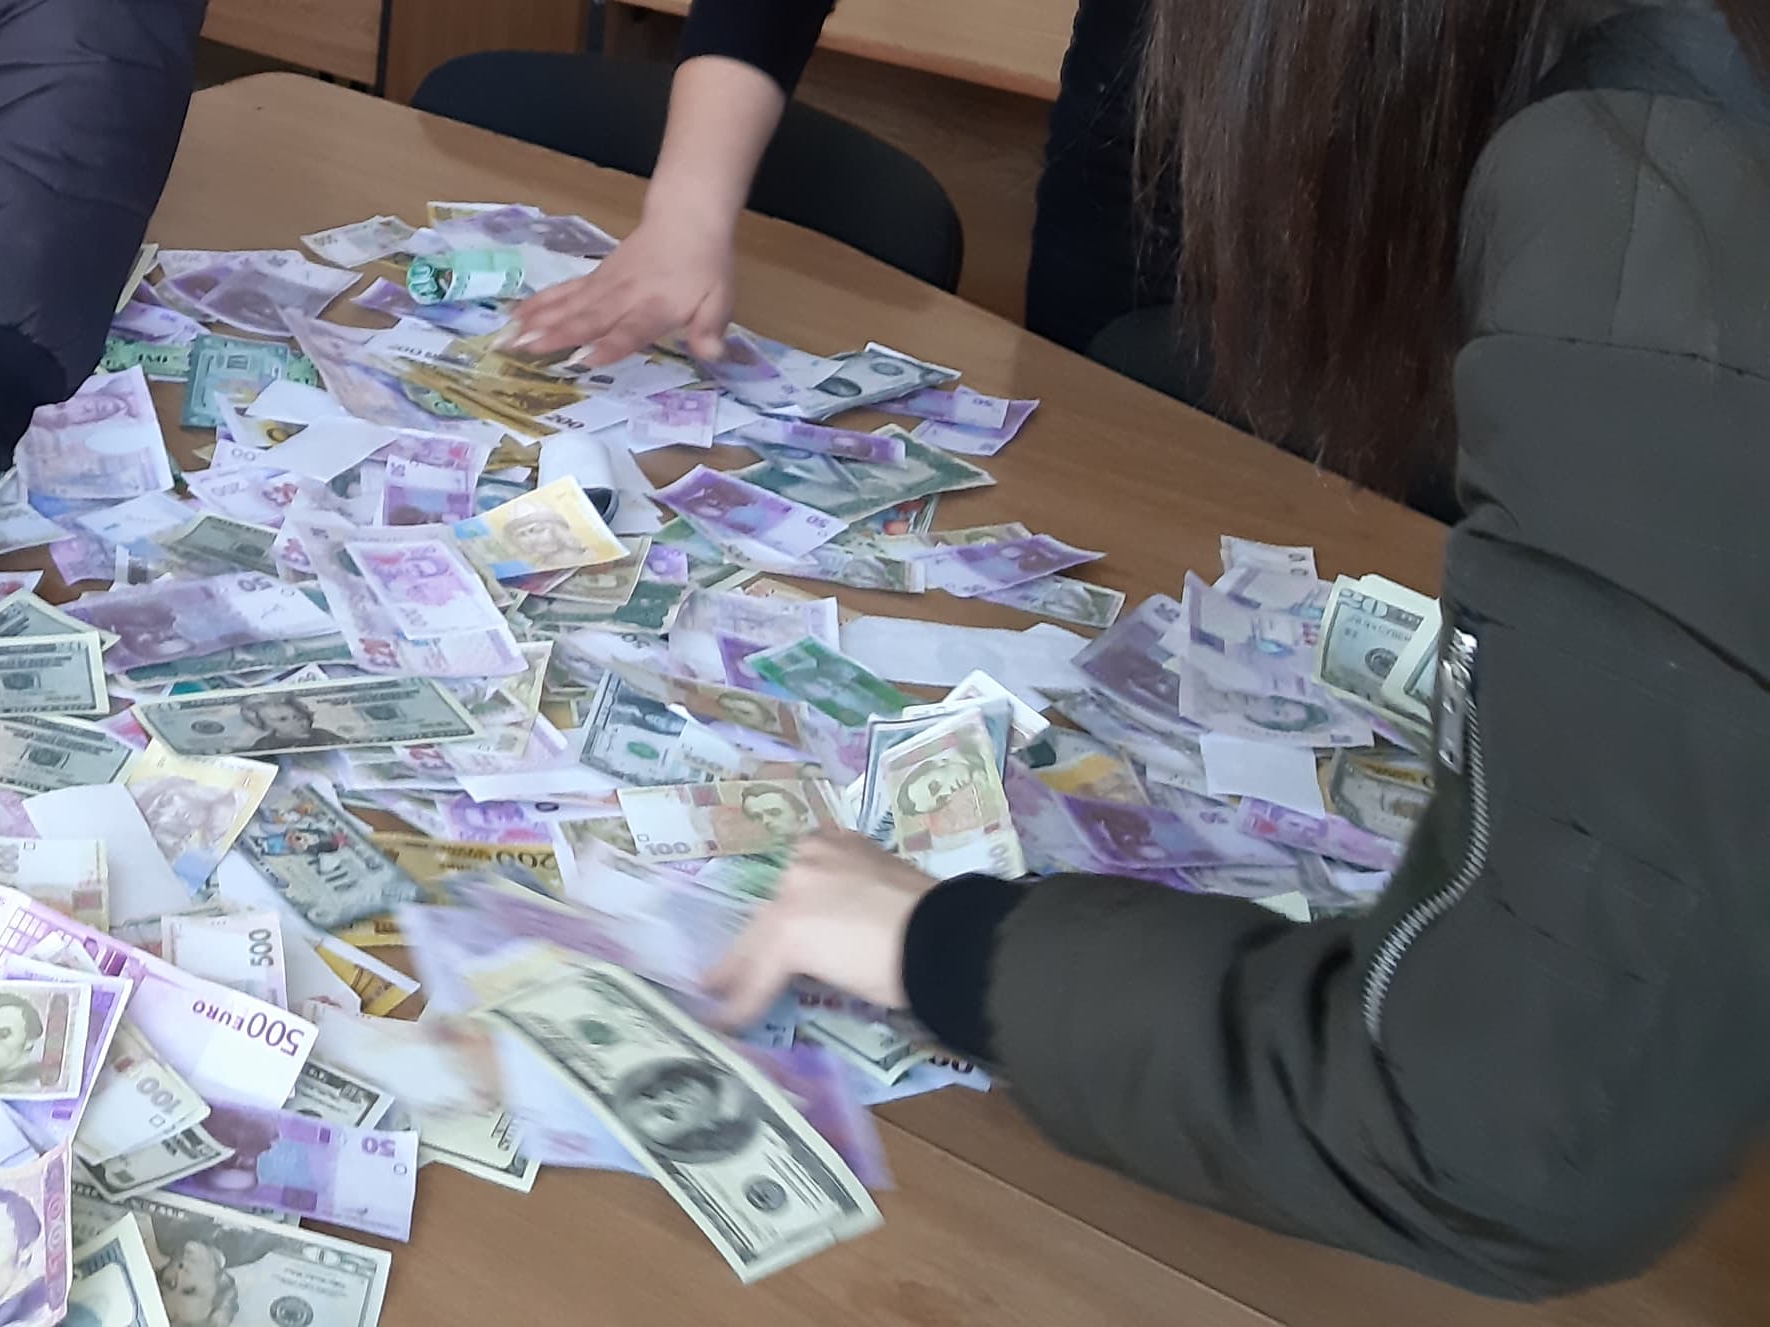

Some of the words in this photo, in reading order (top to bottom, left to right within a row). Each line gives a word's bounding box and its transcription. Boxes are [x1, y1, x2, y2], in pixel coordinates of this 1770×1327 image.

[1338, 587, 1390, 619] 20
[646, 841, 692, 856] 100
[248, 928, 275, 968] 500
[192, 999, 246, 1032] EURO
[246, 1011, 306, 1057] 500
[135, 1077, 184, 1112] 100
[361, 1136, 397, 1158] 50
